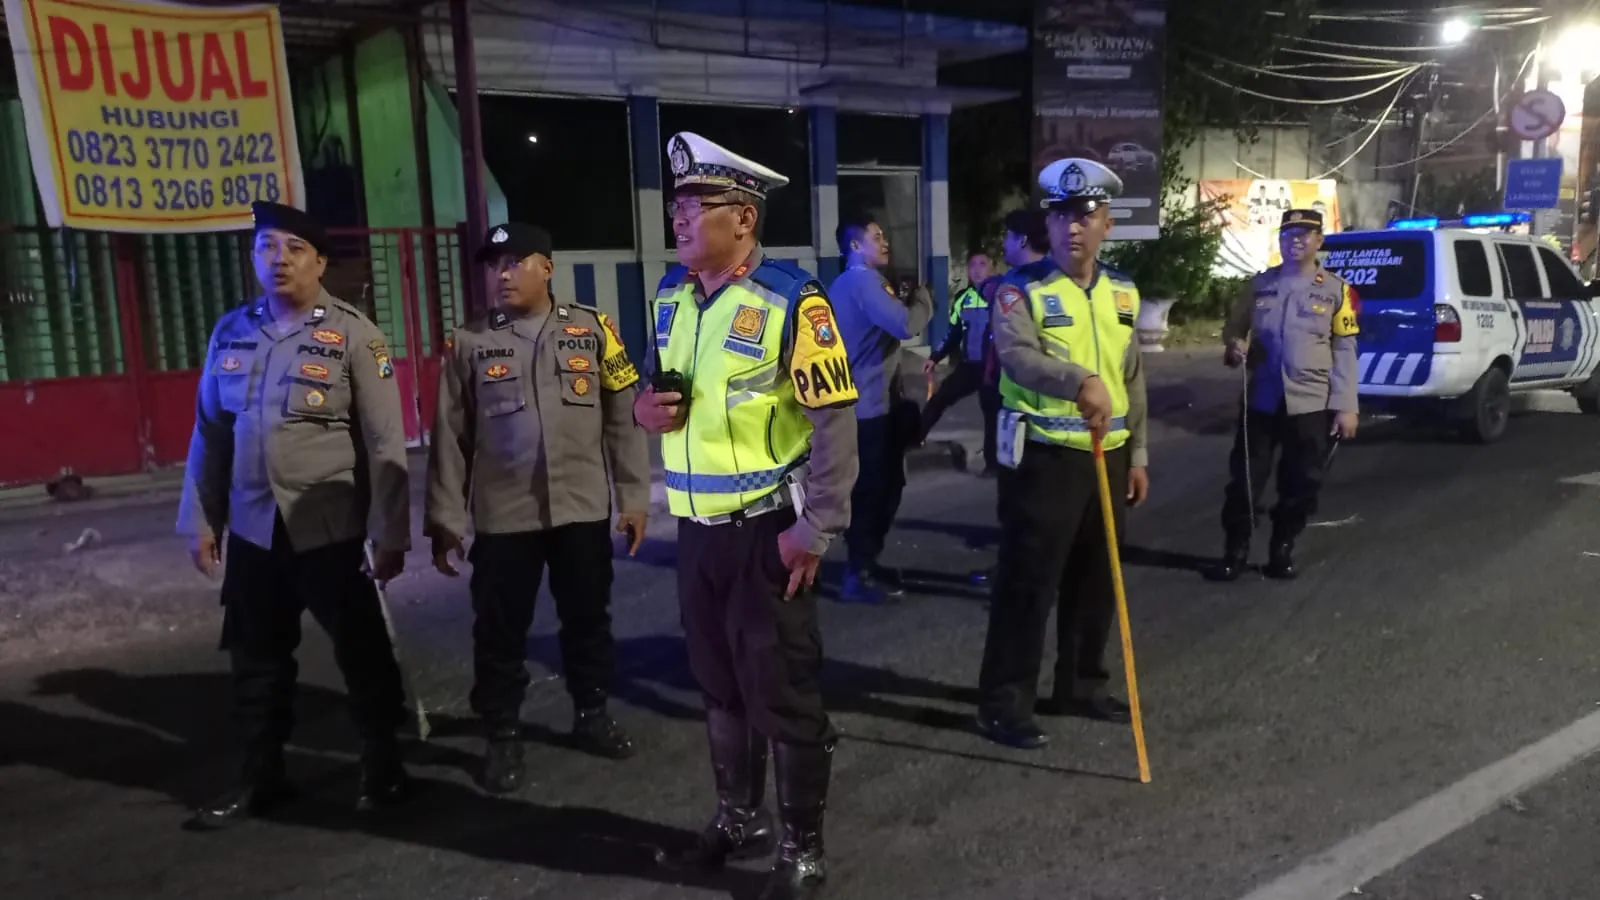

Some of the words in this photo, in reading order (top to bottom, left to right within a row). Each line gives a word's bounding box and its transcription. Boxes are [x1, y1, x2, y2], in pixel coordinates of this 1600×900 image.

[48, 15, 268, 103] DIJUAL
[101, 105, 239, 130] HUBUNGI
[68, 130, 137, 167] 0823
[145, 137, 209, 169] 3770
[217, 133, 276, 167] 2422
[75, 174, 142, 209] 0813
[152, 177, 214, 210] 3266
[223, 173, 280, 205] 9878
[1353, 248, 1391, 258] LANTAS
[297, 344, 344, 361] POLRI
[558, 339, 595, 351] POLRI
[793, 356, 854, 402] PAW
